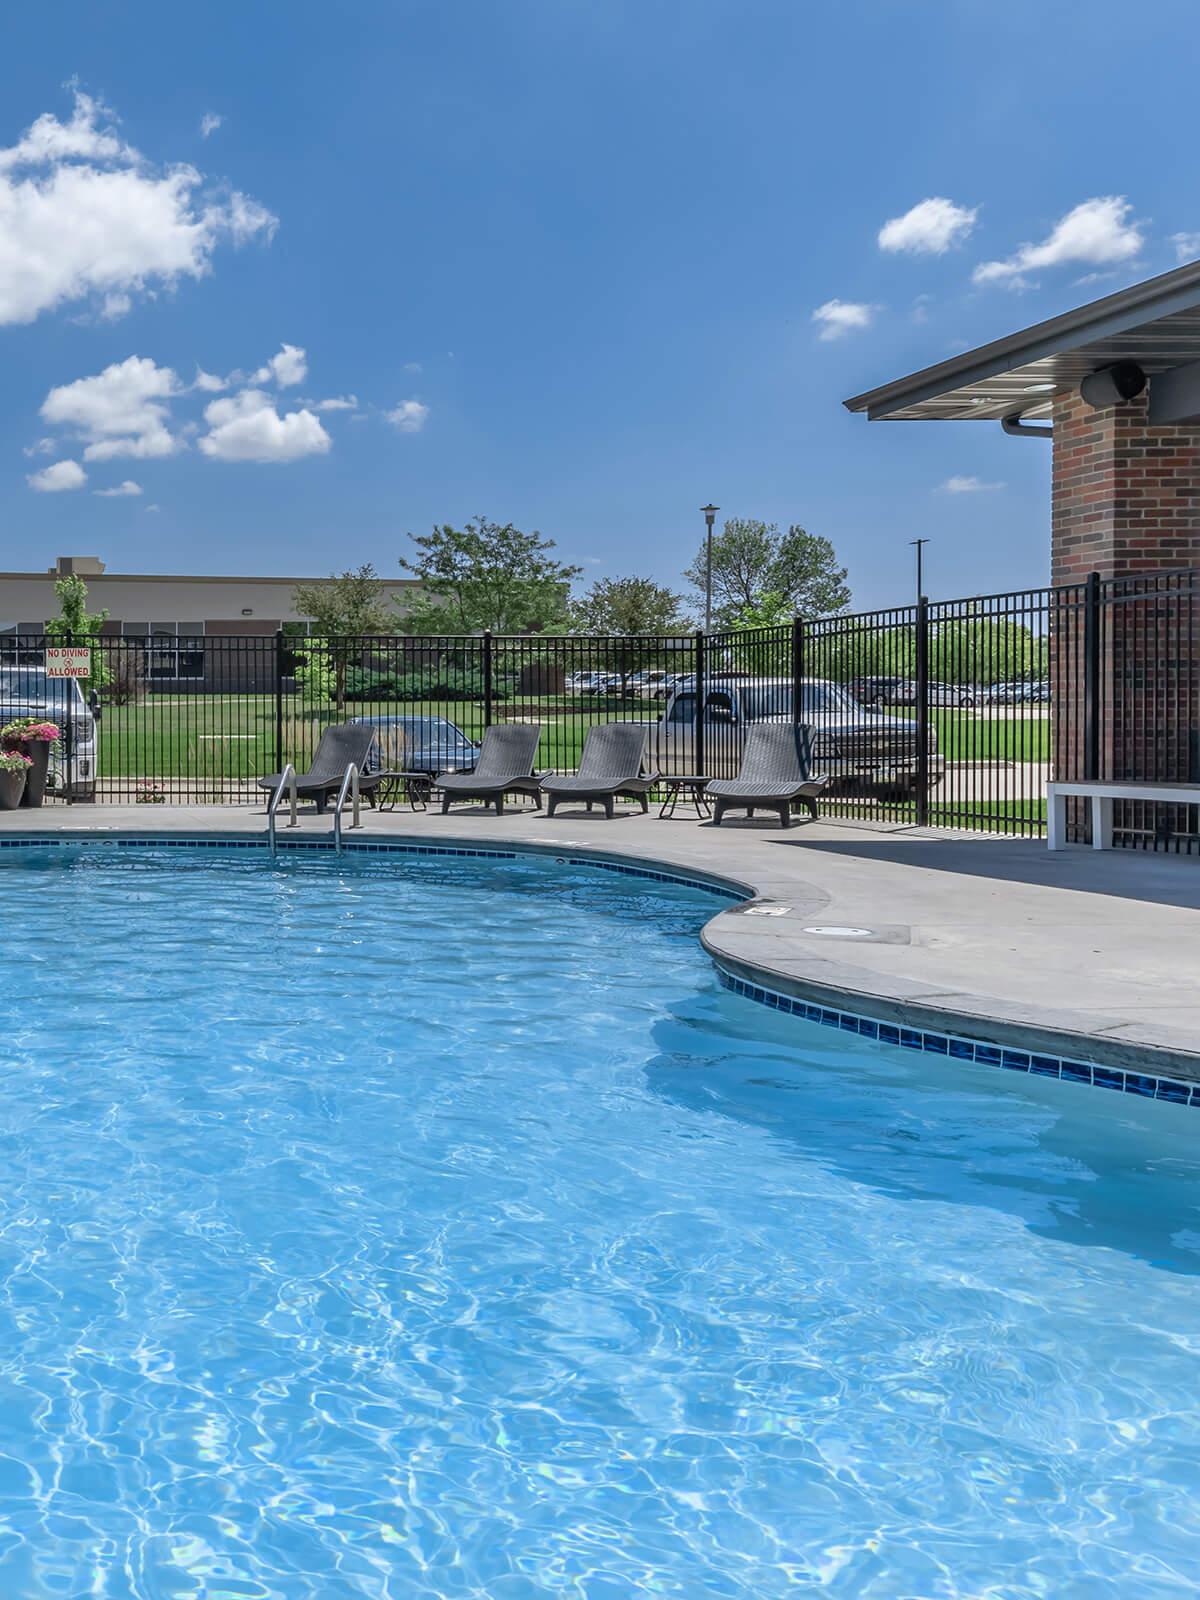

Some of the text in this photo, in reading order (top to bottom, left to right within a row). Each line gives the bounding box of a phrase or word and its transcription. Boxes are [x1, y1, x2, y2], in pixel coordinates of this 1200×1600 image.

[48, 649, 89, 658] NO DIVING
[48, 667, 89, 677] ALLOWED
